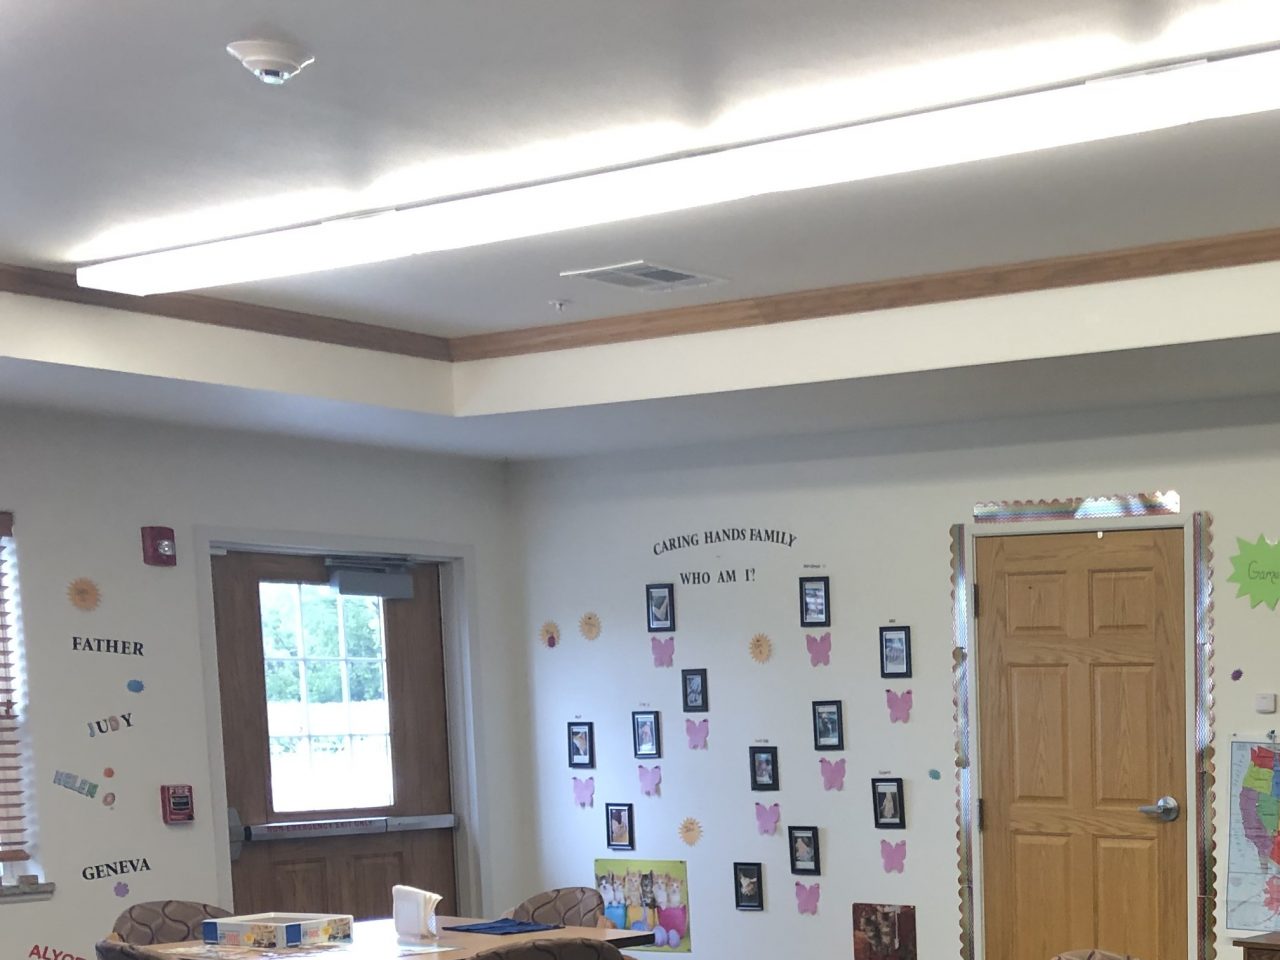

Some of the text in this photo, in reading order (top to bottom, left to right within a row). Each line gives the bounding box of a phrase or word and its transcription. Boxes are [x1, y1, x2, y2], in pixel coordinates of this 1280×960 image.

[652, 528, 797, 556] CARING HANDS FAMILY
[679, 567, 756, 585] WHO AM I?
[72, 636, 145, 657] FATHER
[87, 712, 134, 738] JUDY
[169, 786, 191, 795] FIRE
[81, 857, 152, 880] GENEVA
